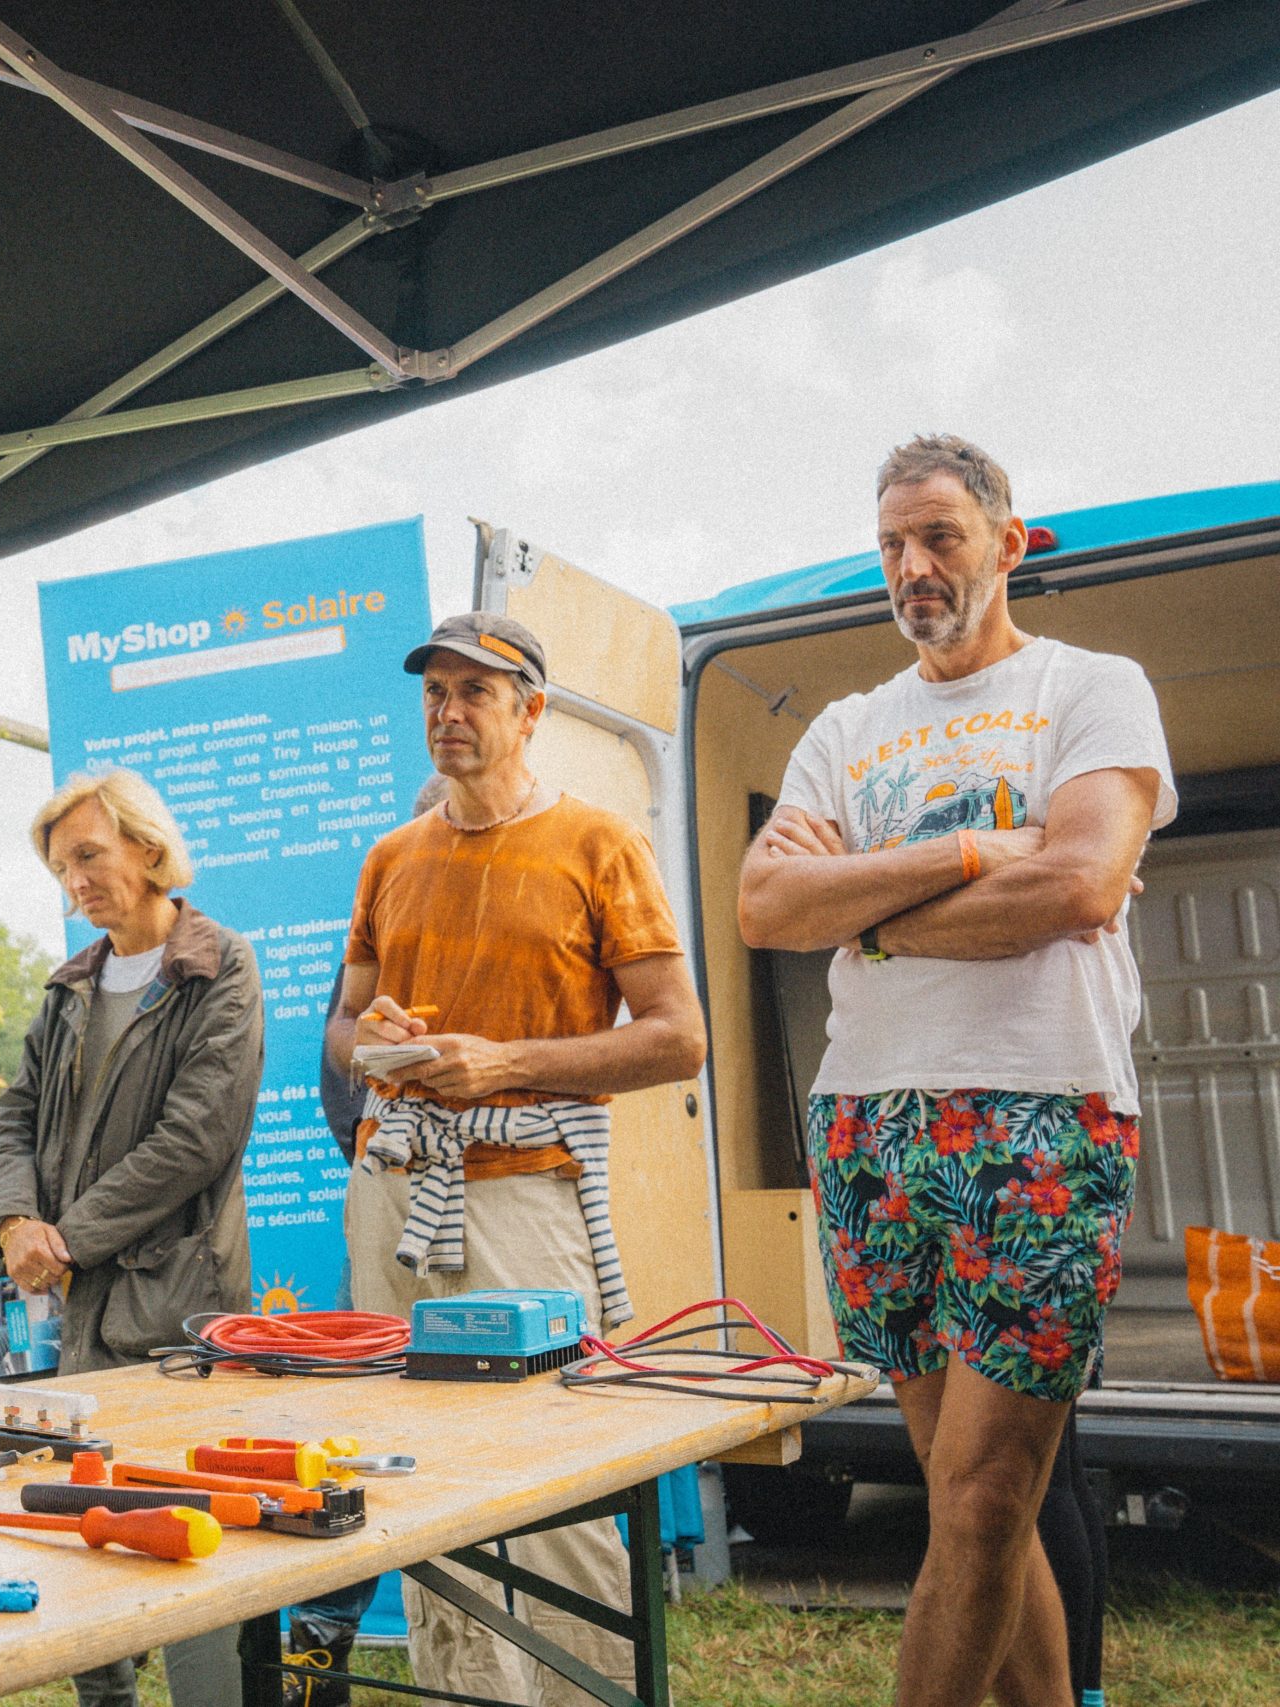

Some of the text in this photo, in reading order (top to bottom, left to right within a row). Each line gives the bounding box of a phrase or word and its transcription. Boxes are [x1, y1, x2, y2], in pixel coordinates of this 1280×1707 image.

[67, 619, 211, 664] MyShop
[262, 590, 386, 630] Solaire
[84, 737, 120, 752] Votre
[172, 723, 209, 738] notre
[213, 713, 272, 735] passion.
[119, 751, 152, 765] votre
[158, 742, 197, 761] projet
[203, 732, 267, 752] concerne
[272, 727, 300, 741] une
[370, 714, 388, 727] un
[233, 753, 260, 767] une
[272, 747, 301, 760] Tiny
[313, 738, 359, 754] House
[371, 734, 390, 746] ou
[847, 724, 934, 782] WEST
[945, 709, 1050, 740] COAST
[227, 772, 261, 787] nous
[268, 762, 329, 781] sommes
[336, 756, 350, 770] là
[358, 752, 391, 769] pour
[358, 772, 394, 787] nous
[196, 817, 221, 830] vos
[228, 807, 283, 826] besoins
[290, 804, 309, 817] en
[318, 794, 371, 813] énergie
[380, 791, 395, 804] et
[245, 811, 397, 842] votre installation
[281, 837, 340, 857] adaptée
[351, 833, 361, 848] à
[268, 924, 284, 939] et
[265, 940, 333, 960] logistique
[264, 960, 332, 979] nos colis
[283, 984, 301, 998] de
[274, 1004, 310, 1019] dans
[282, 1084, 307, 1101] été
[258, 1110, 292, 1124] vous
[256, 1148, 304, 1168] guides
[307, 1146, 325, 1160] de
[268, 1208, 330, 1227] sécurité.
